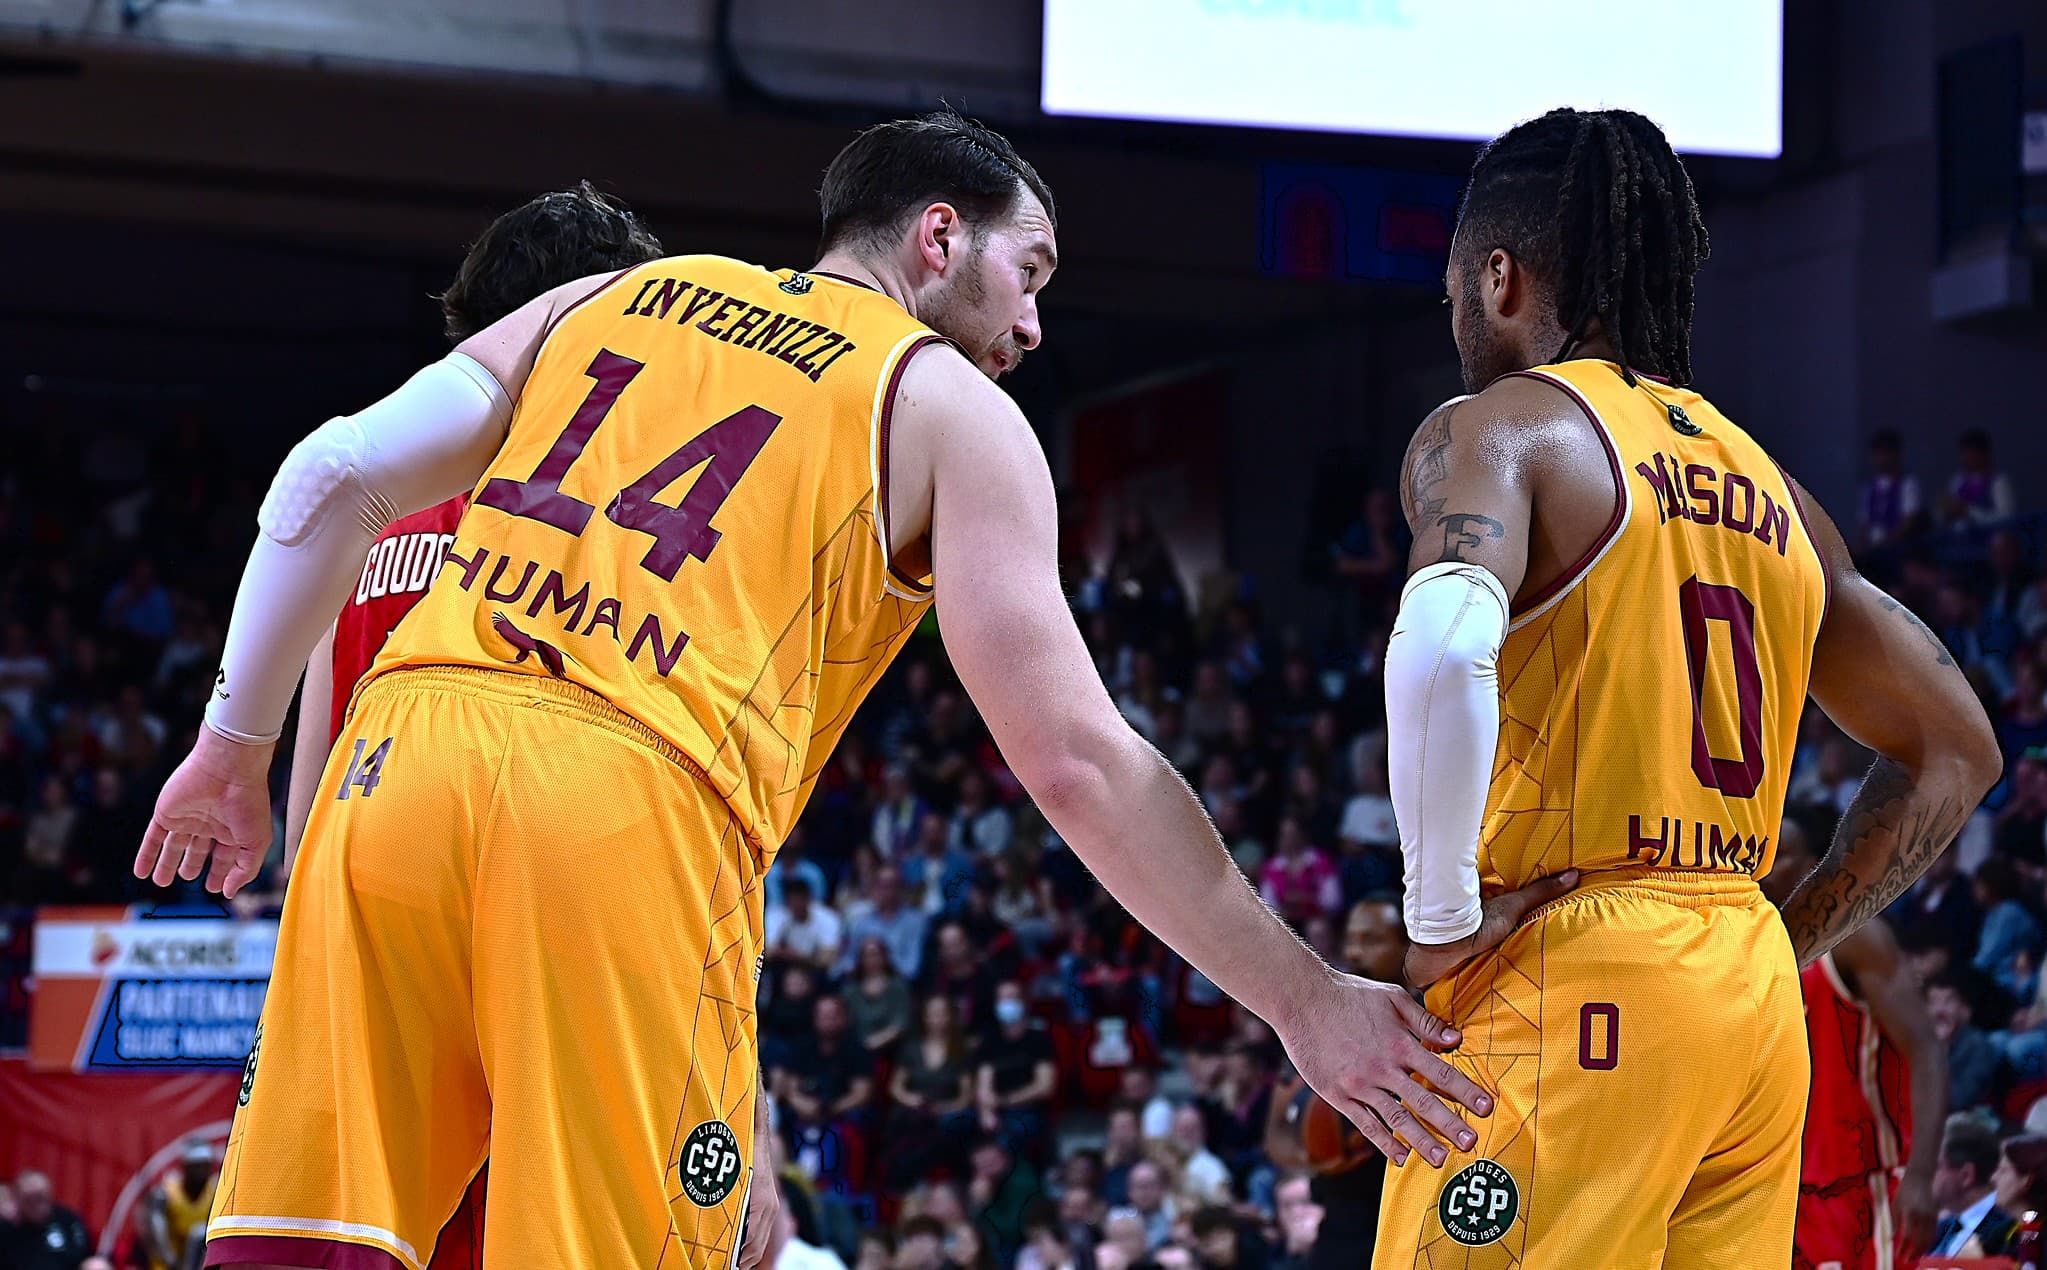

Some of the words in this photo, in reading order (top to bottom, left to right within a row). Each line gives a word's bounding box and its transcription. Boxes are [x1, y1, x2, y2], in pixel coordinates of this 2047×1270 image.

[623, 278, 856, 383] INVERNIZZI
[473, 348, 783, 583] 14
[445, 547, 690, 677] HUMAN
[1679, 573, 1765, 799] 0
[336, 737, 393, 800] 14
[1579, 1003, 1619, 1070] 0
[686, 1137, 737, 1183] CSP
[698, 1123, 735, 1147] LIMOGES
[686, 1180, 707, 1203] DEPUIS
[1447, 1175, 1509, 1220] CSP
[1447, 1220, 1477, 1241] DEPUIS
